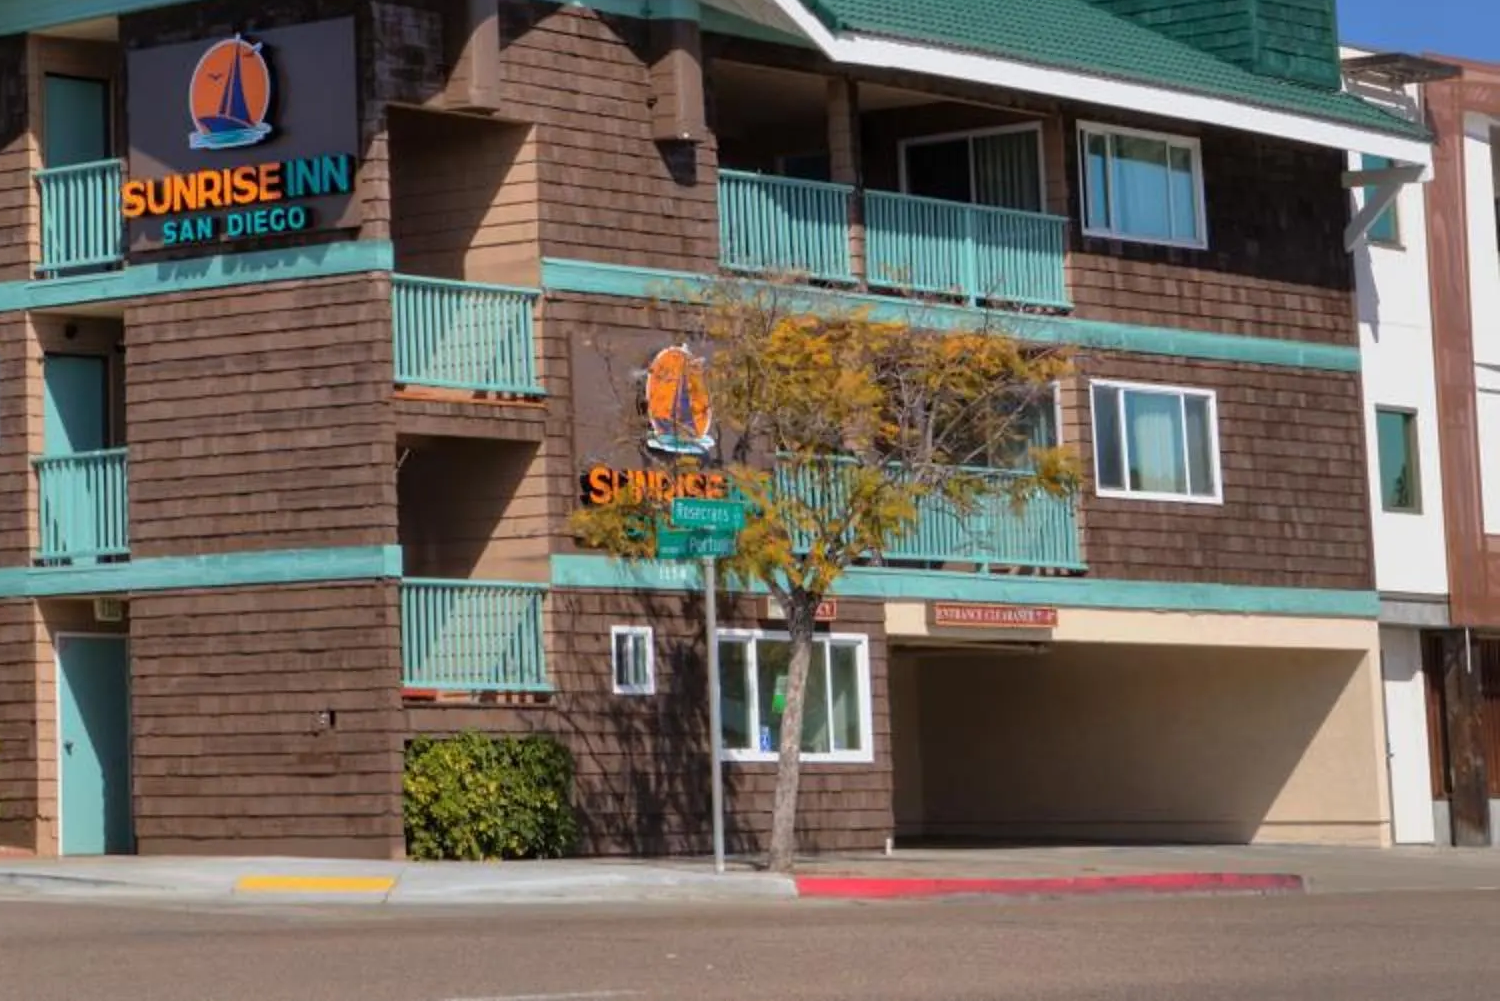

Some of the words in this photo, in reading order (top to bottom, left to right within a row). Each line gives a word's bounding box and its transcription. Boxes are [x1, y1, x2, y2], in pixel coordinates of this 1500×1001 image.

[121, 162, 283, 218] SUNRISE
[284, 153, 350, 196] INN
[162, 215, 213, 244] SAN
[226, 205, 306, 237] DIEGO
